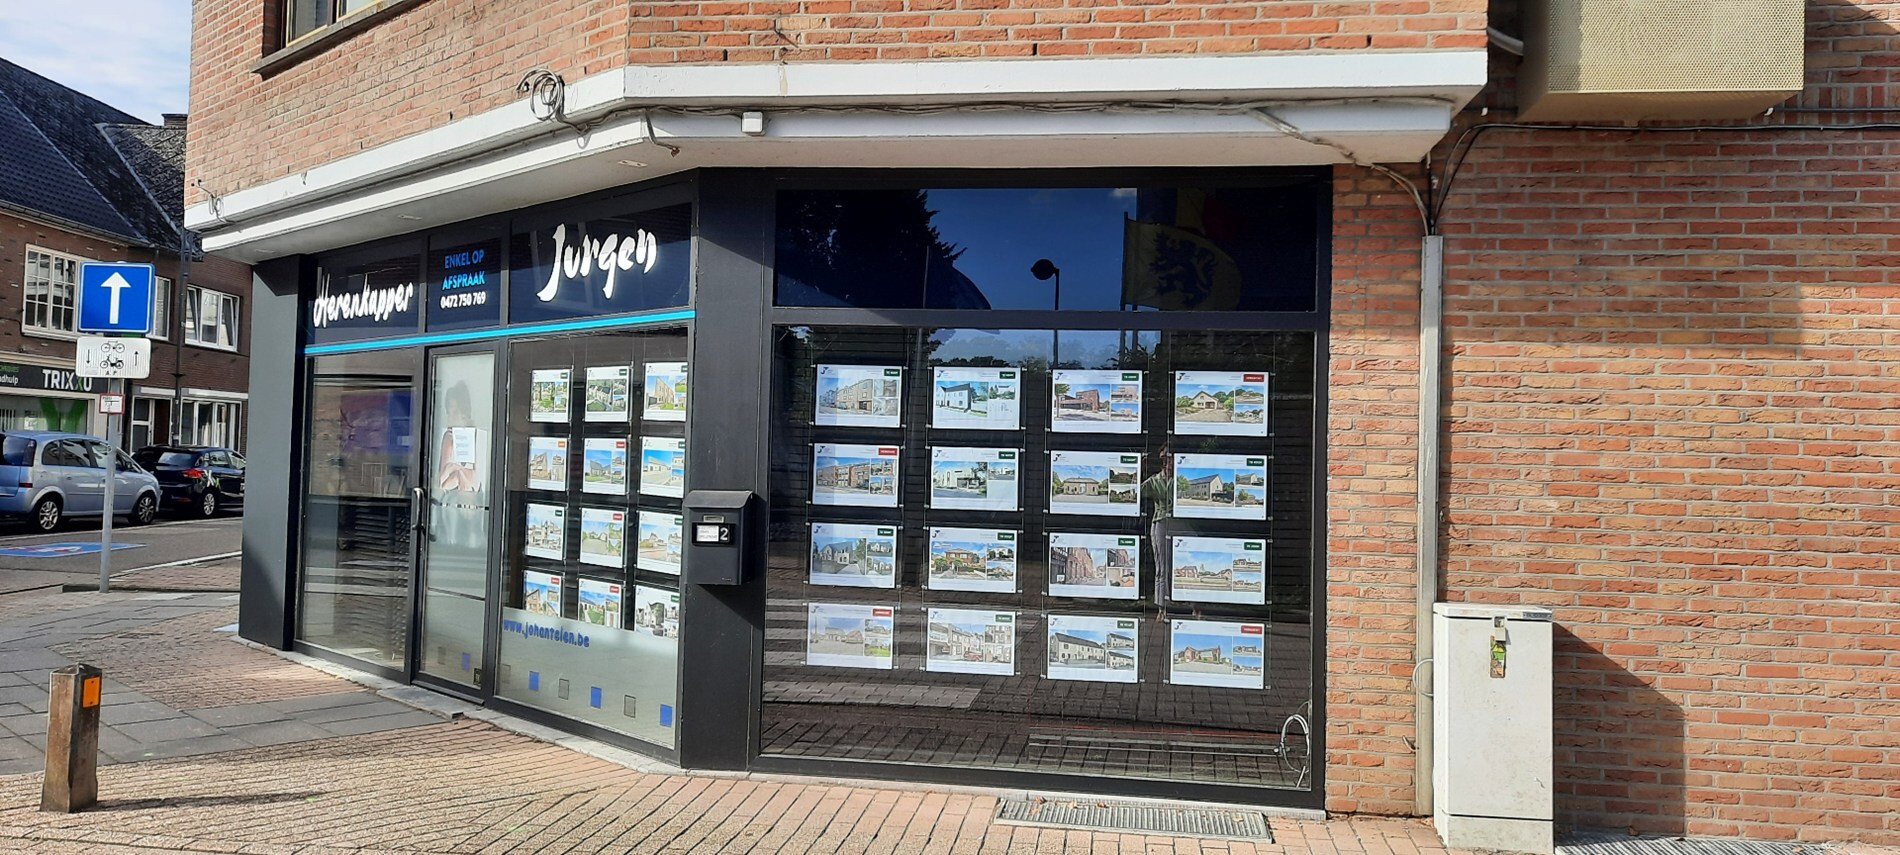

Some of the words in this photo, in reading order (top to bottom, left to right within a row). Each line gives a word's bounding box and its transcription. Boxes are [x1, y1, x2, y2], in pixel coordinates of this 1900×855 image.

[444, 252, 470, 269] ENKEL
[472, 249, 485, 264] OP
[536, 223, 657, 302] Jurgen
[442, 270, 486, 290] AFSPRAAK
[313, 273, 414, 328] Herenkapper
[440, 294, 458, 309] 0472
[458, 293, 472, 307] 750
[473, 291, 487, 306] 769
[720, 527, 728, 541] 2
